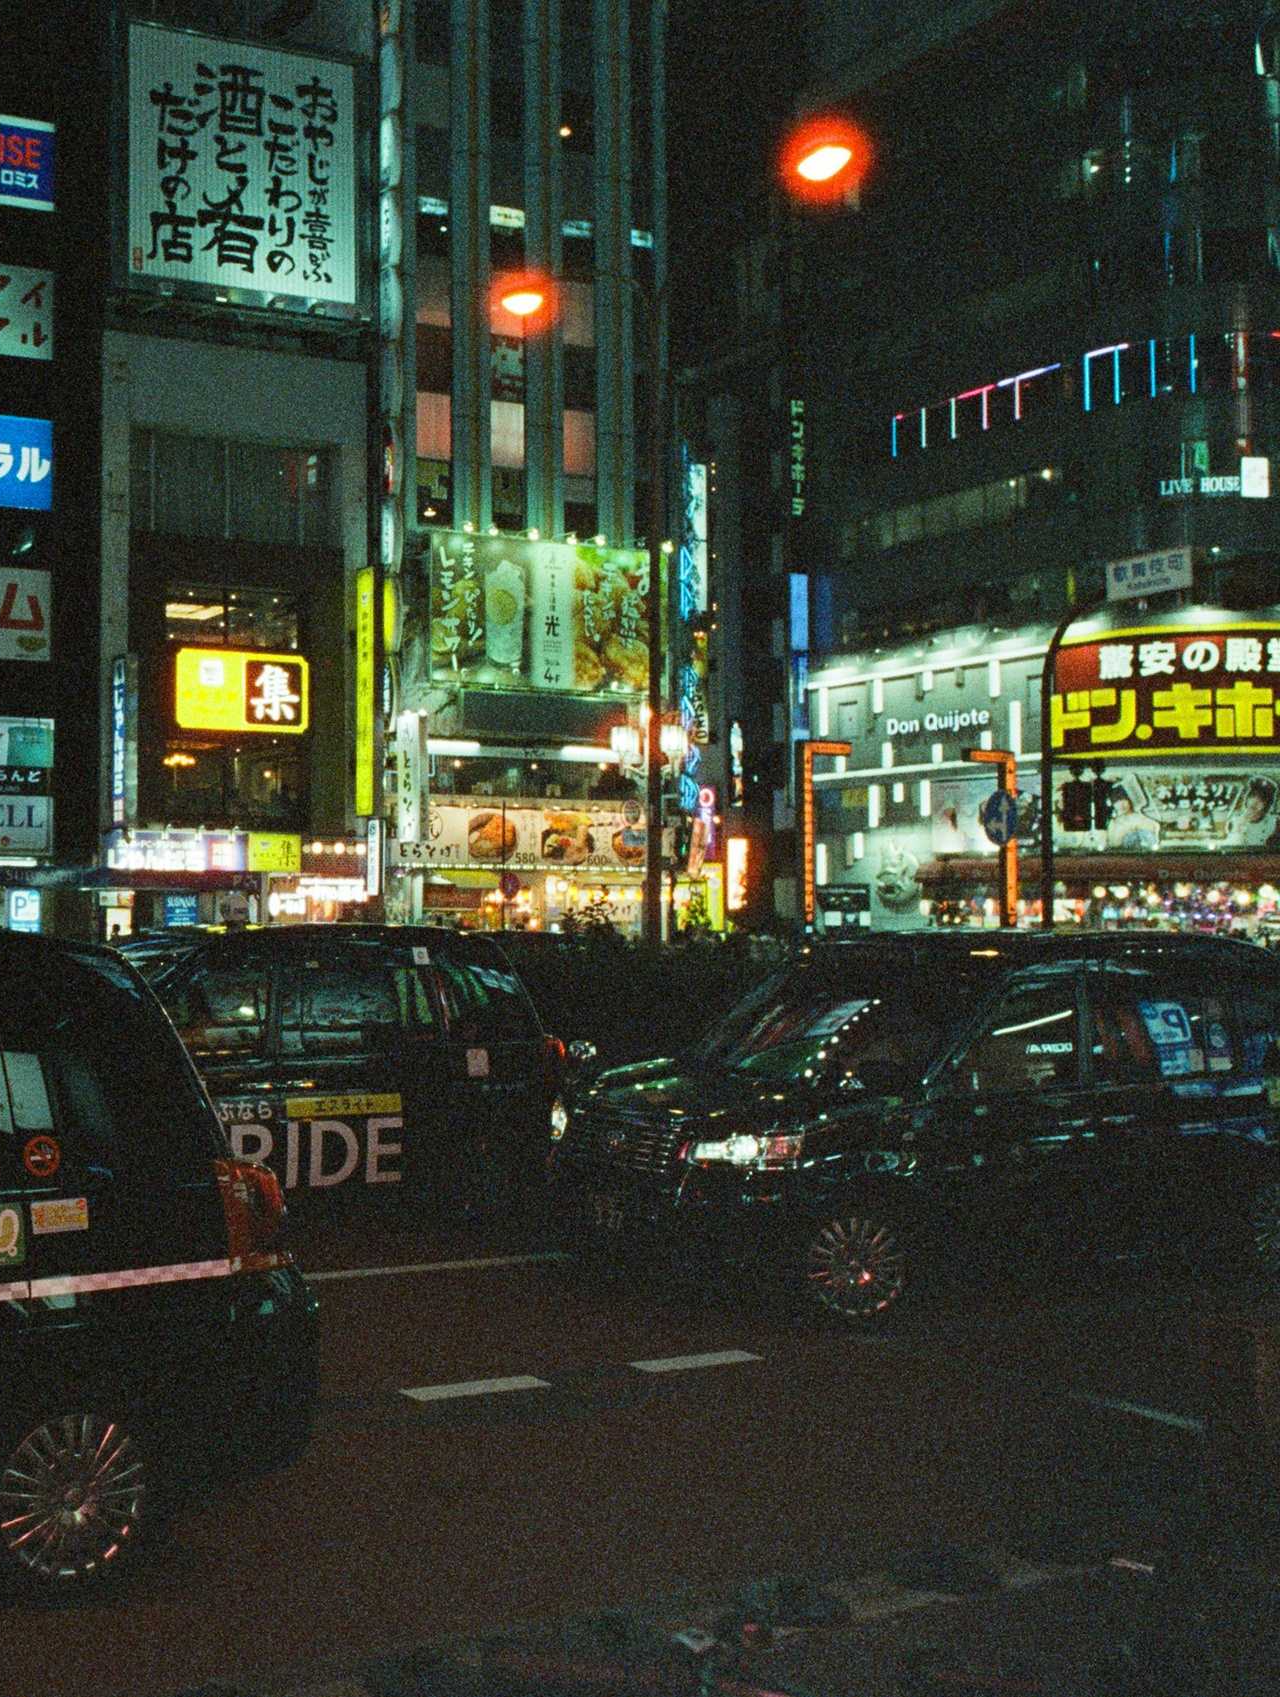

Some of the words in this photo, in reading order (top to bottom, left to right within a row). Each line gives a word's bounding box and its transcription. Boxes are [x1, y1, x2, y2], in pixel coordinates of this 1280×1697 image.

[148, 82, 197, 265] だけの店
[1160, 478, 1194, 497] LIVE
[1200, 475, 1241, 493] HOUSE
[544, 614, 561, 638] 光
[249, 662, 300, 722] 集
[886, 717, 920, 736] Don
[924, 709, 991, 733] Quijote
[515, 851, 536, 865] 580
[586, 854, 608, 867] 600
